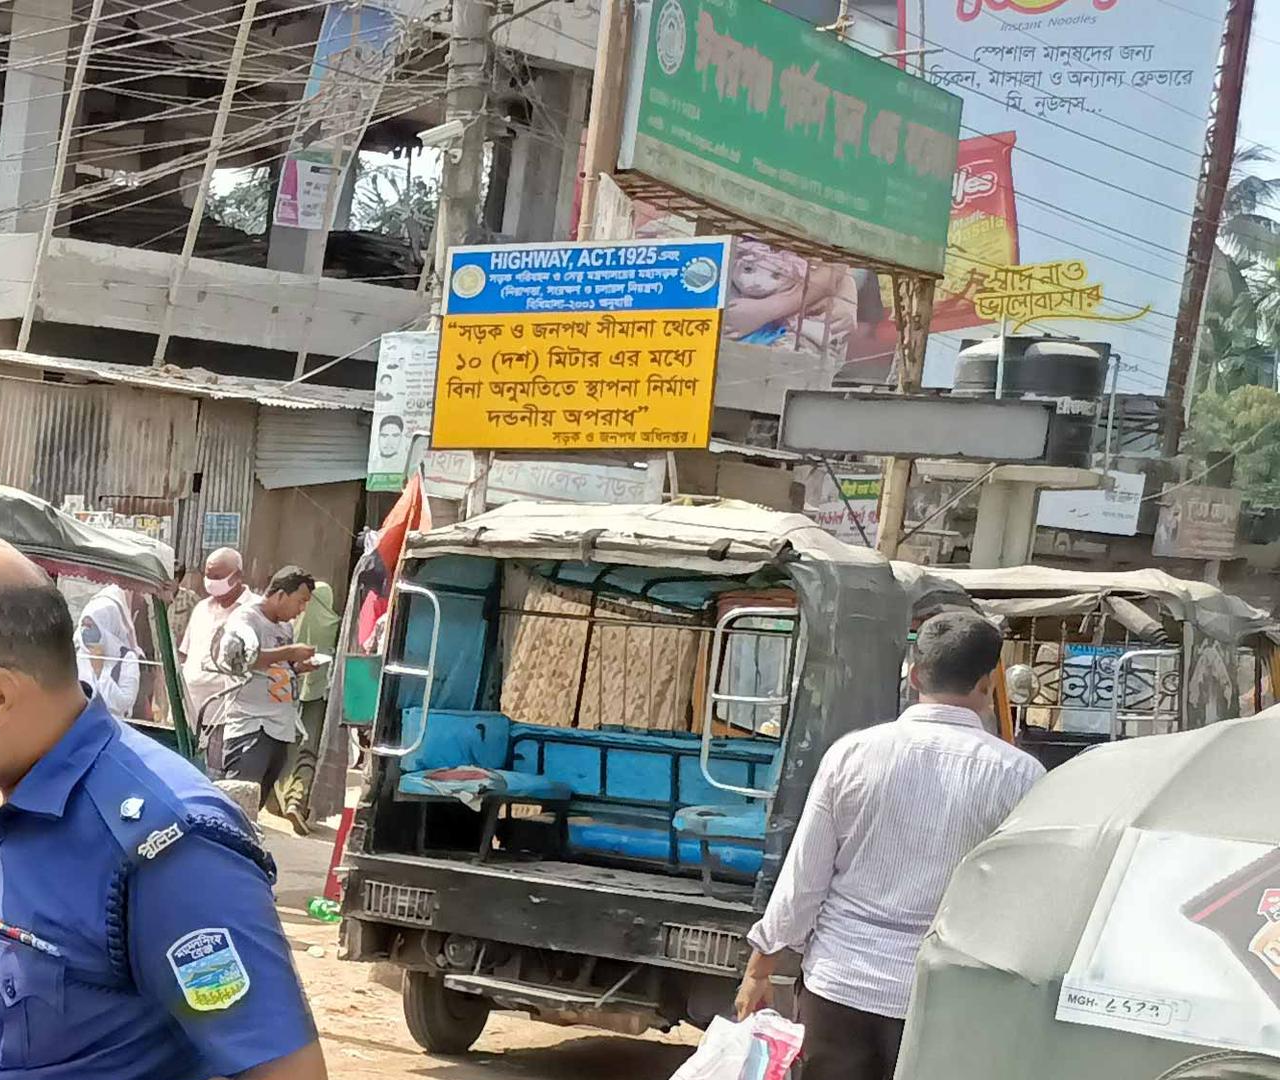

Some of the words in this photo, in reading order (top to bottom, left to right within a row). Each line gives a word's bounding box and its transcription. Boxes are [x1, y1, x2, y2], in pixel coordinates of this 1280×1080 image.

[999, 20, 1041, 33] Instant
[1047, 13, 1097, 28] Noodles
[973, 46, 1035, 64] স্পেশাল
[1043, 45, 1112, 67] মানুষদের
[1119, 44, 1154, 60] জন্য
[989, 69, 1042, 88] মাসালা
[1050, 72, 1062, 86] ও
[490, 249, 574, 271] HIGHWAY,
[577, 246, 657, 267] ACT.1925
[1040, 262, 1085, 286] নাও
[977, 285, 1101, 318] ভালোবাসার
[511, 323, 524, 340] ও
[532, 320, 590, 340] জনপথ
[596, 315, 657, 340] সীমানা
[663, 317, 713, 338] থেকে
[456, 353, 482, 371] ১০
[491, 350, 539, 374] (দশ)
[548, 345, 600, 369] মিটার
[609, 348, 640, 368] এর
[649, 348, 697, 368] মধ্যে
[447, 376, 483, 399] বিনা
[490, 375, 578, 402] অনুমতিতে
[584, 379, 640, 401] স্থাপনা
[646, 372, 699, 398] নির্মাণ
[552, 431, 580, 444] সড়ক
[586, 432, 594, 443] ও
[599, 432, 637, 443] জনপথ
[596, 474, 646, 500] সড়ক
[138, 822, 184, 859] পুলিশ
